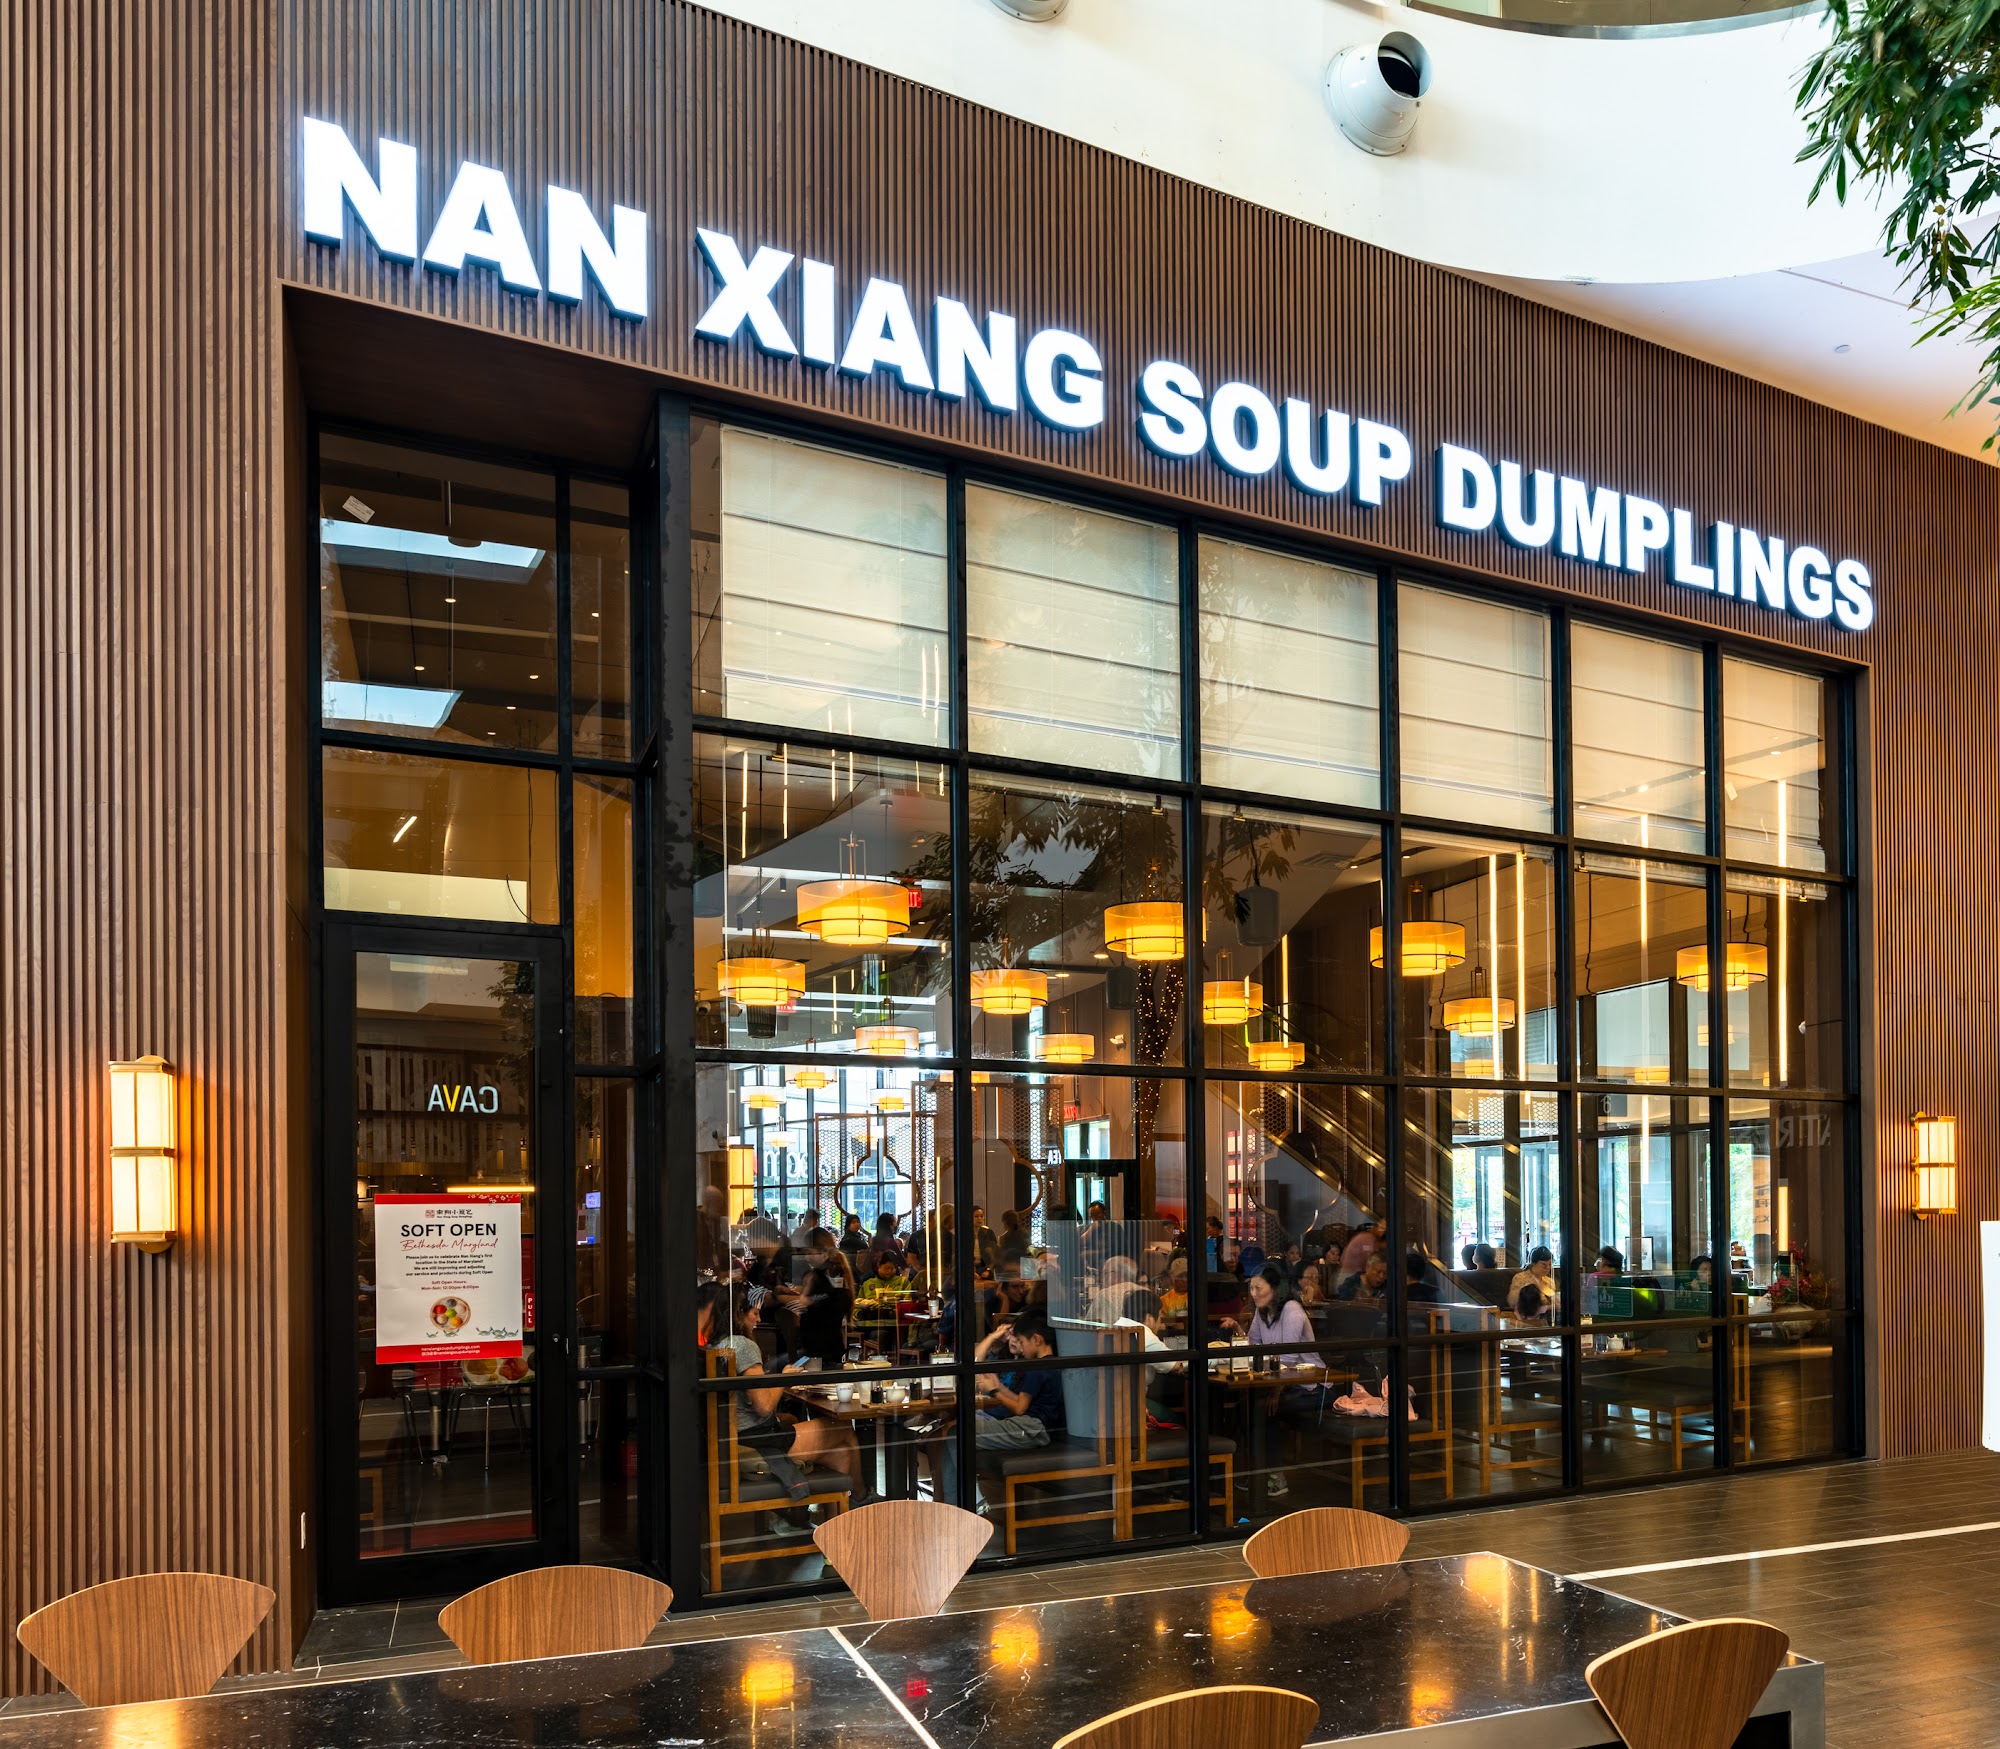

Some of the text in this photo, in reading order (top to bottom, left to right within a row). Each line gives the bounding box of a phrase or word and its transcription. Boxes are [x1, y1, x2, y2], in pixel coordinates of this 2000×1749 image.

[303, 115, 1874, 632] NAN XIANG SOUP DUMPLINGS
[401, 1223, 497, 1237] SOFT OPEN
[400, 1237, 499, 1253] Bethesda Maryland
